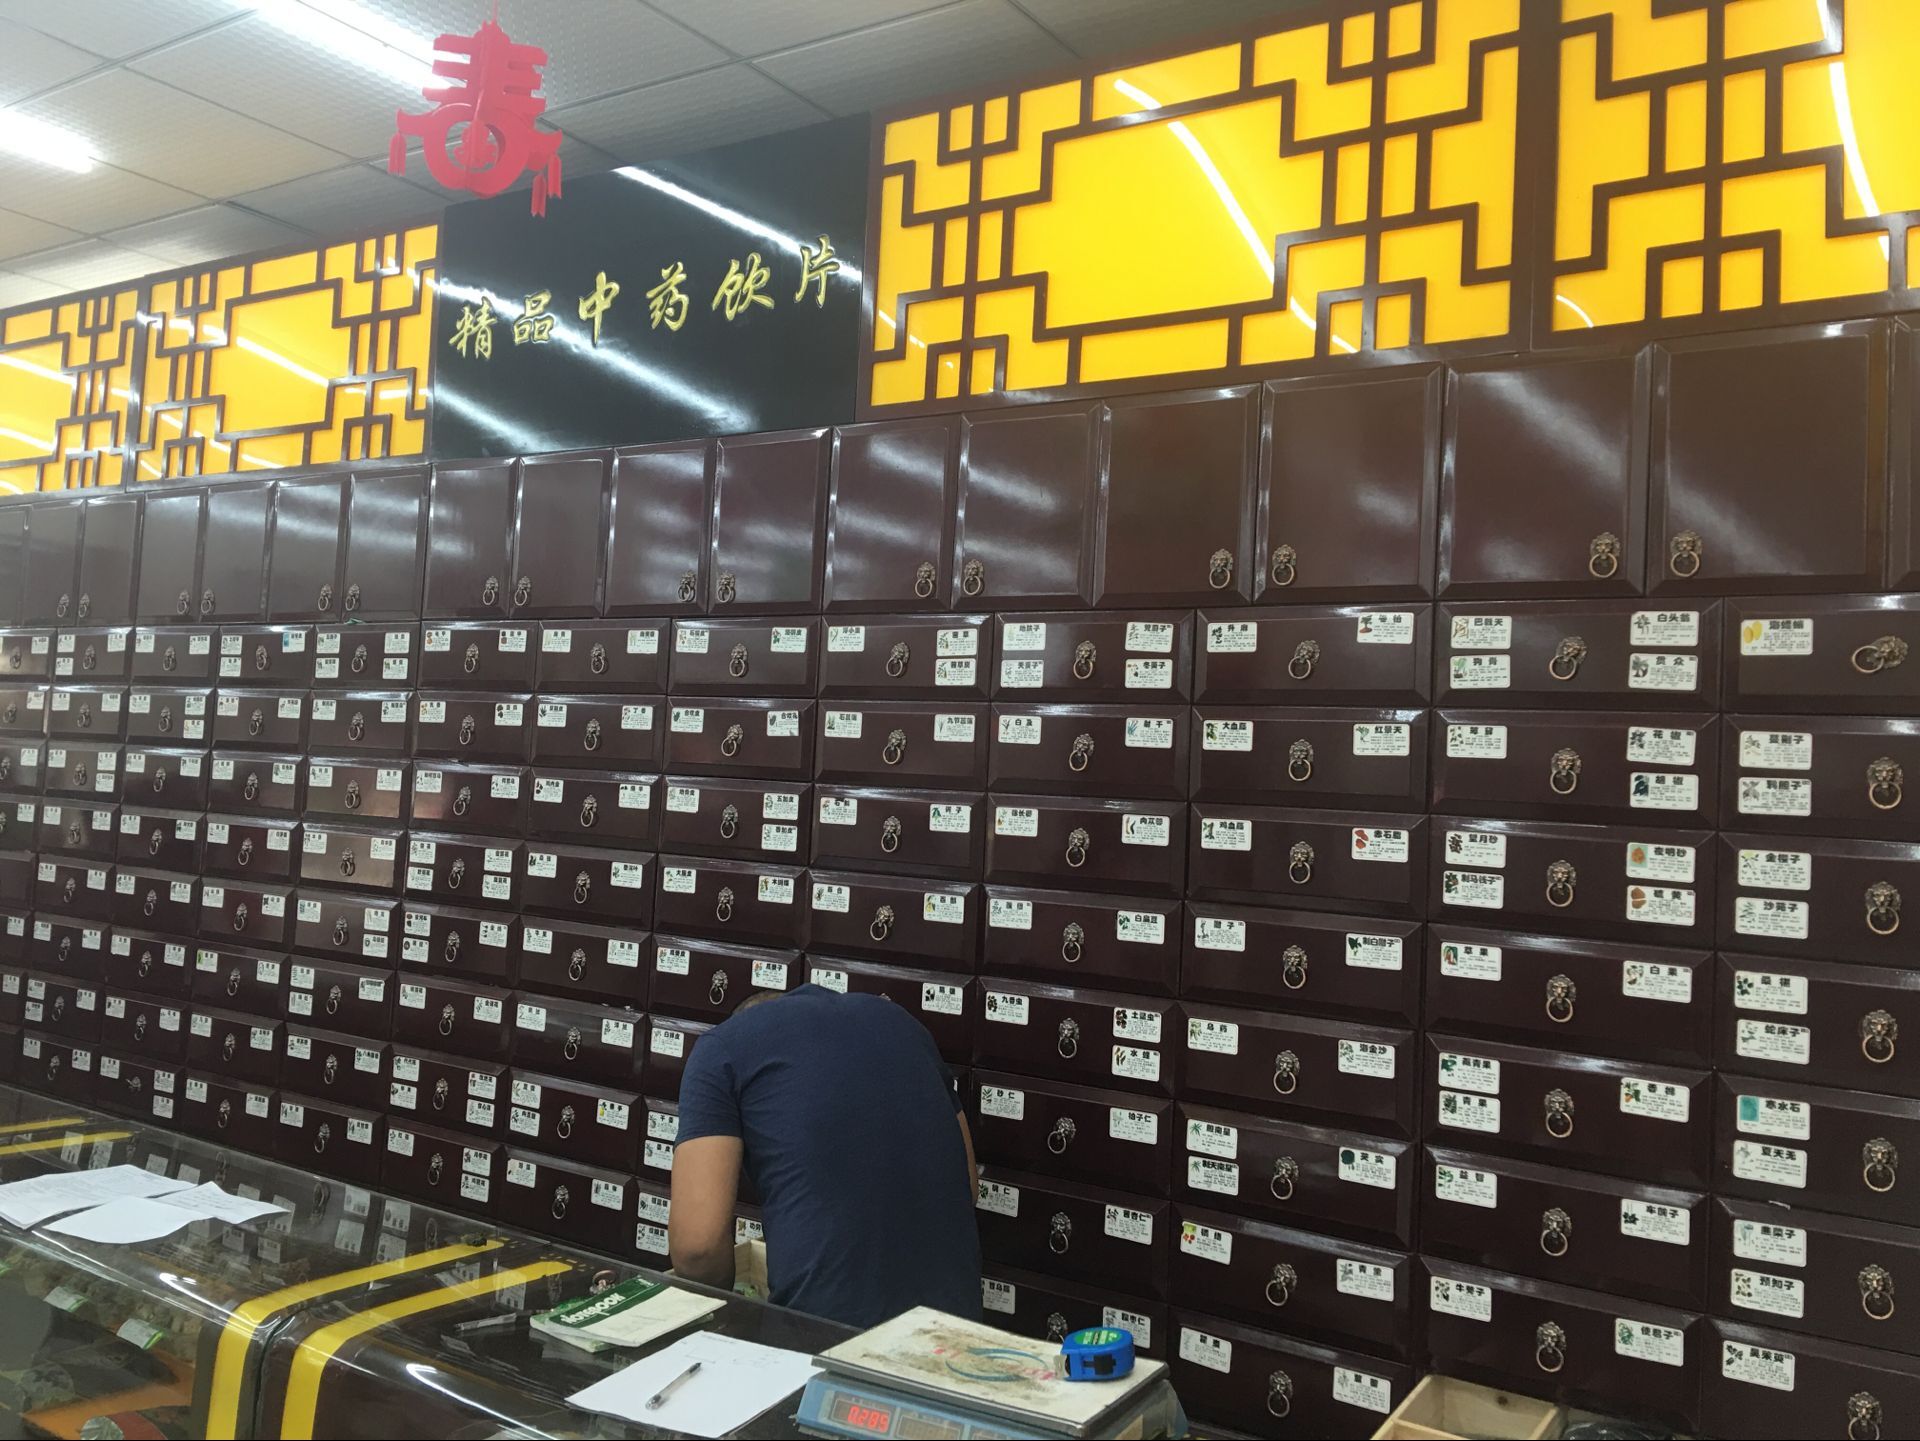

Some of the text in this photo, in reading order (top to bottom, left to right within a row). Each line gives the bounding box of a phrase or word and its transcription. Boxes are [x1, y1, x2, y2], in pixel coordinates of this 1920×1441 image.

[448, 234, 841, 361] 精品中药饮片
